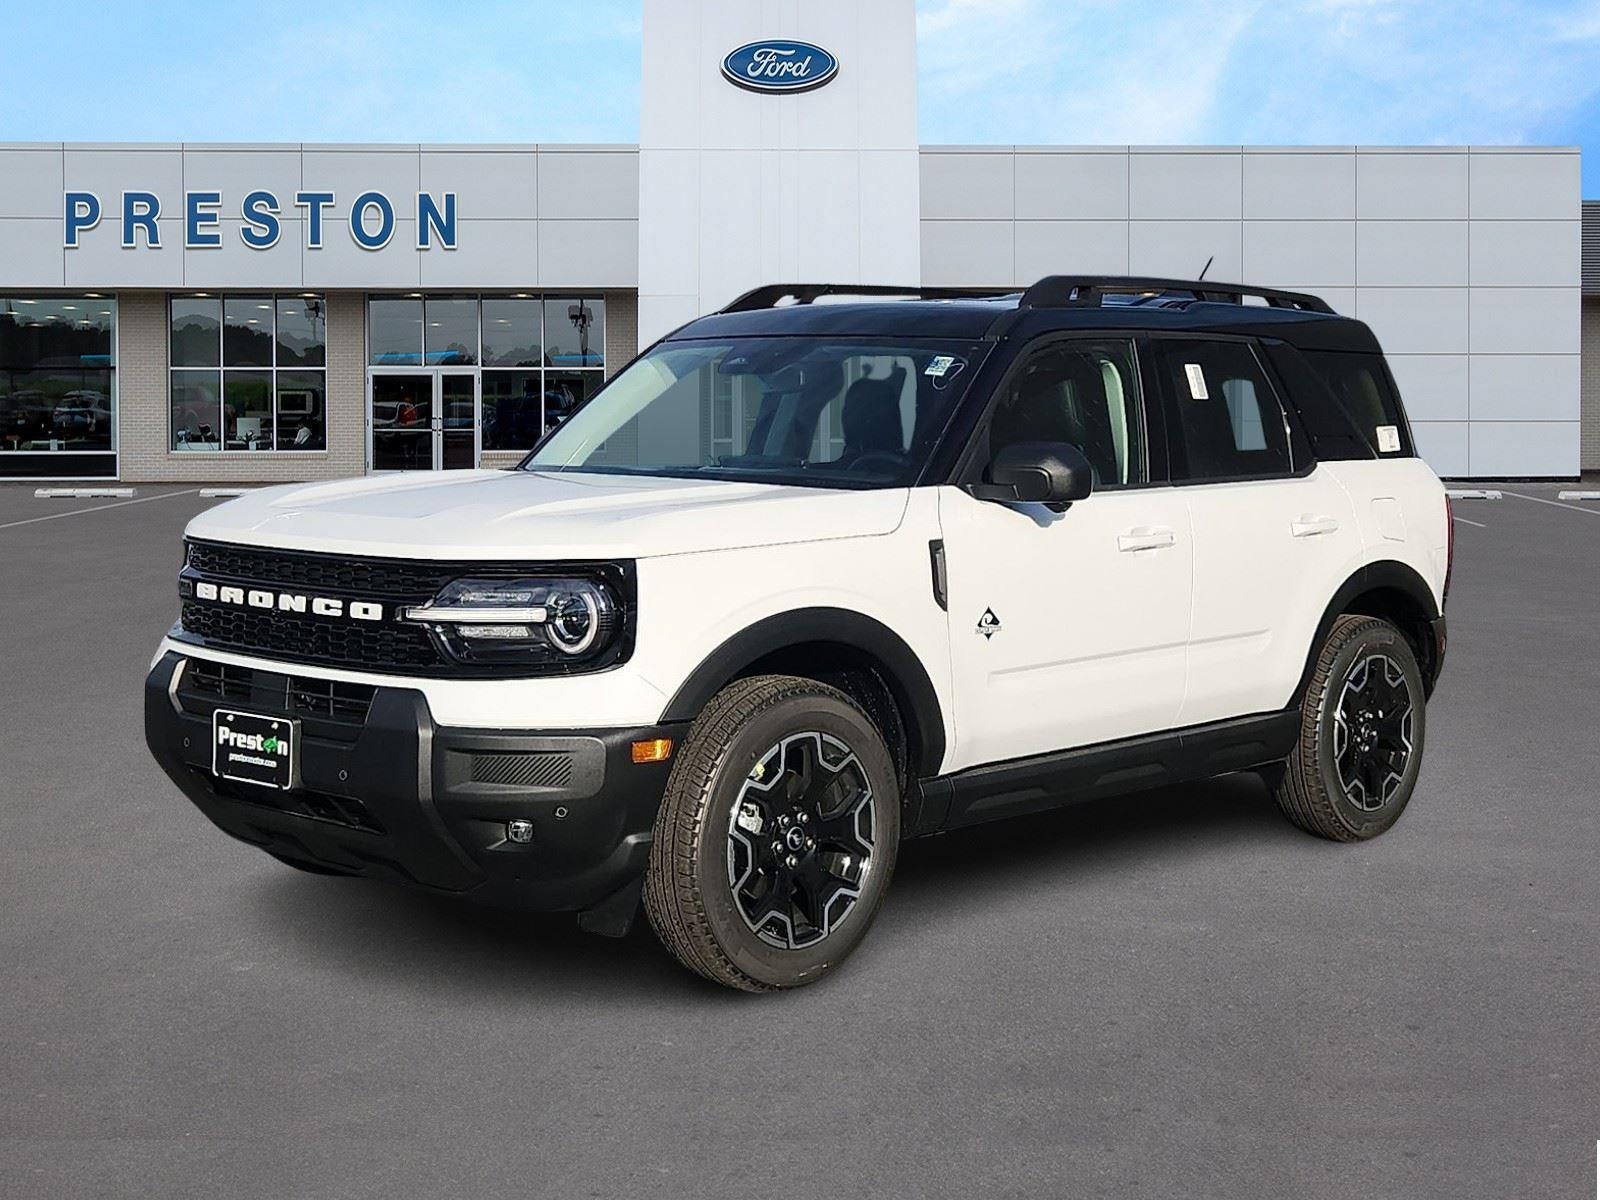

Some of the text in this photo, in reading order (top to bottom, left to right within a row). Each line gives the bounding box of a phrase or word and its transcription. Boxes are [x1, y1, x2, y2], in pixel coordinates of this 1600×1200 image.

[746, 48, 812, 77] Ford
[63, 191, 458, 250] PRESTON
[196, 582, 382, 621] BRONCO
[218, 725, 288, 756] Preston
